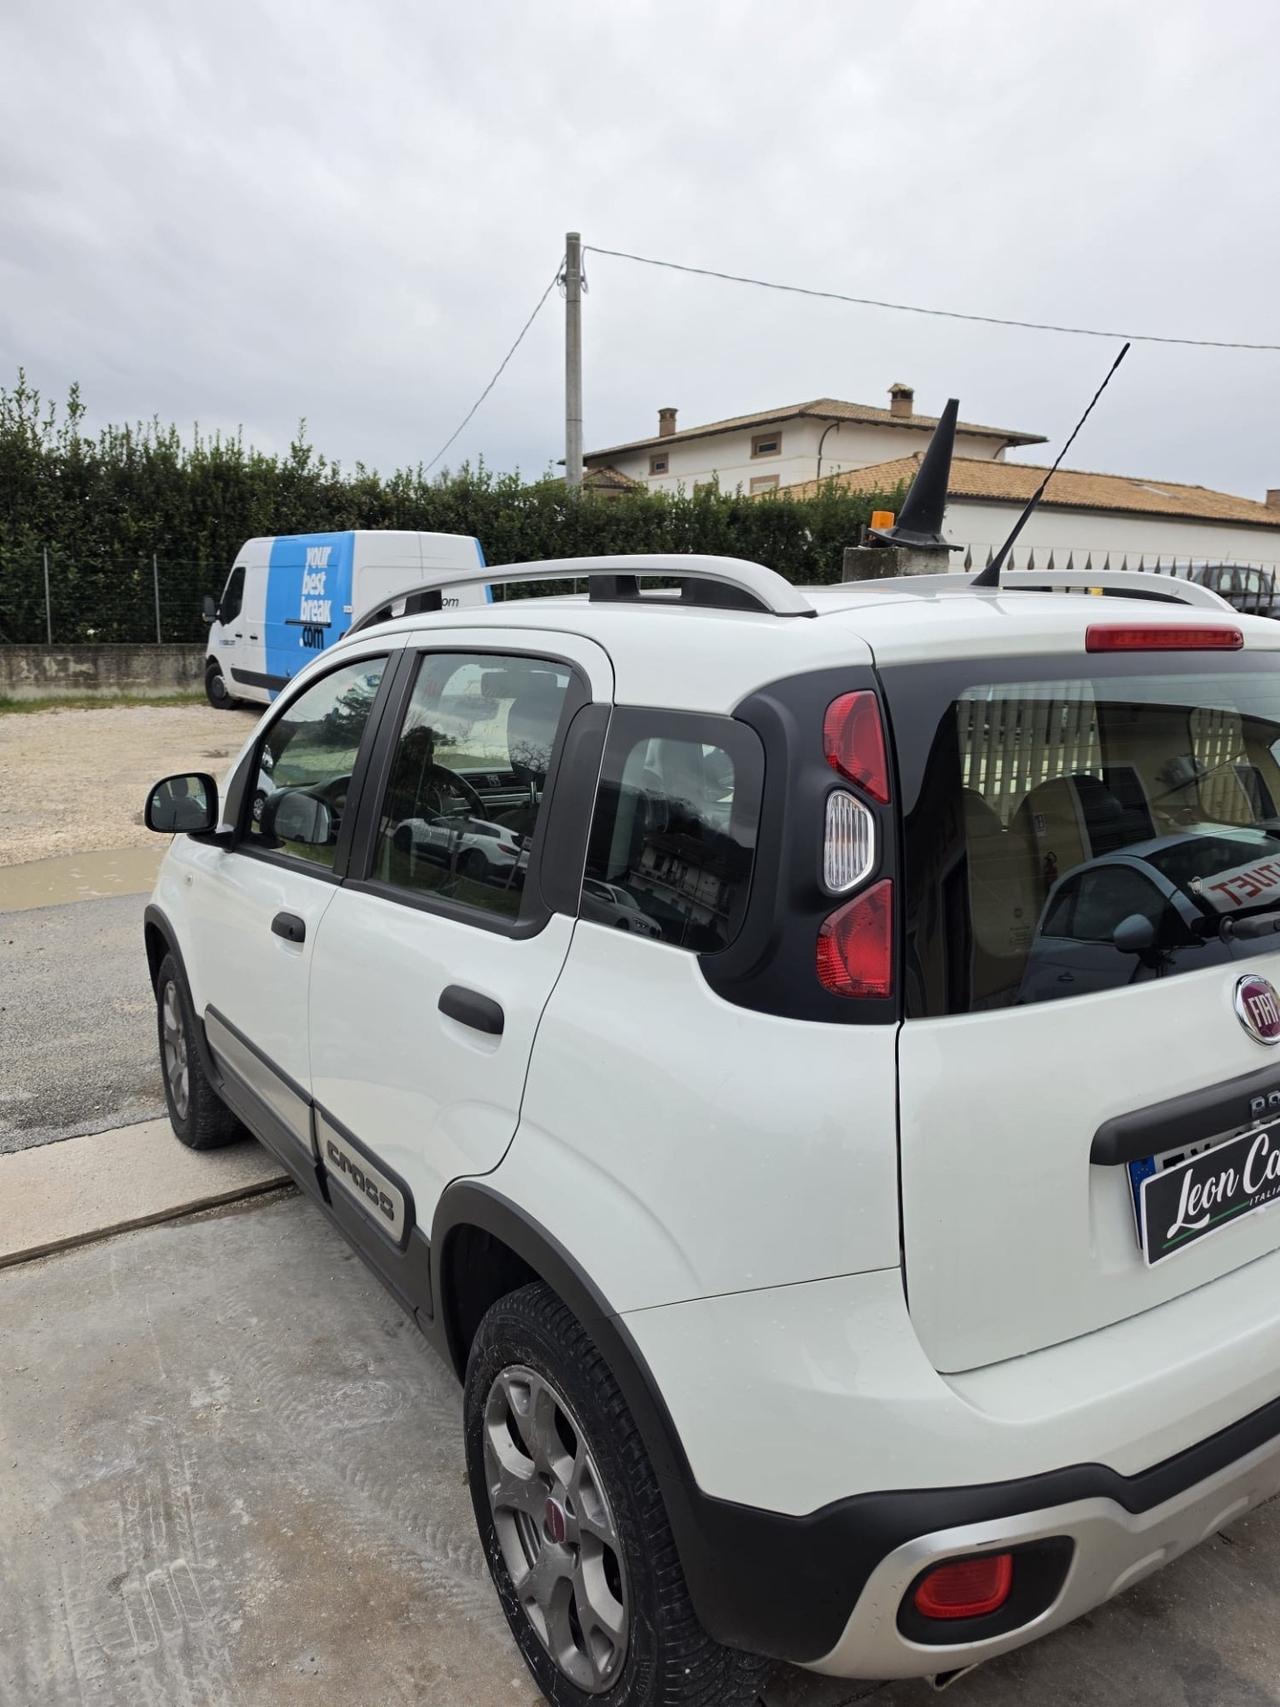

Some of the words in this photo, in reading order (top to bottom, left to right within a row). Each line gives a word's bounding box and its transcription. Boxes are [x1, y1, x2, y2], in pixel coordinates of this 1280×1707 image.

[305, 546, 332, 570] your
[302, 571, 326, 595] best
[301, 595, 331, 623] break
[1248, 992, 1279, 1027] FIAT
[1166, 1168, 1239, 1239] Leon
